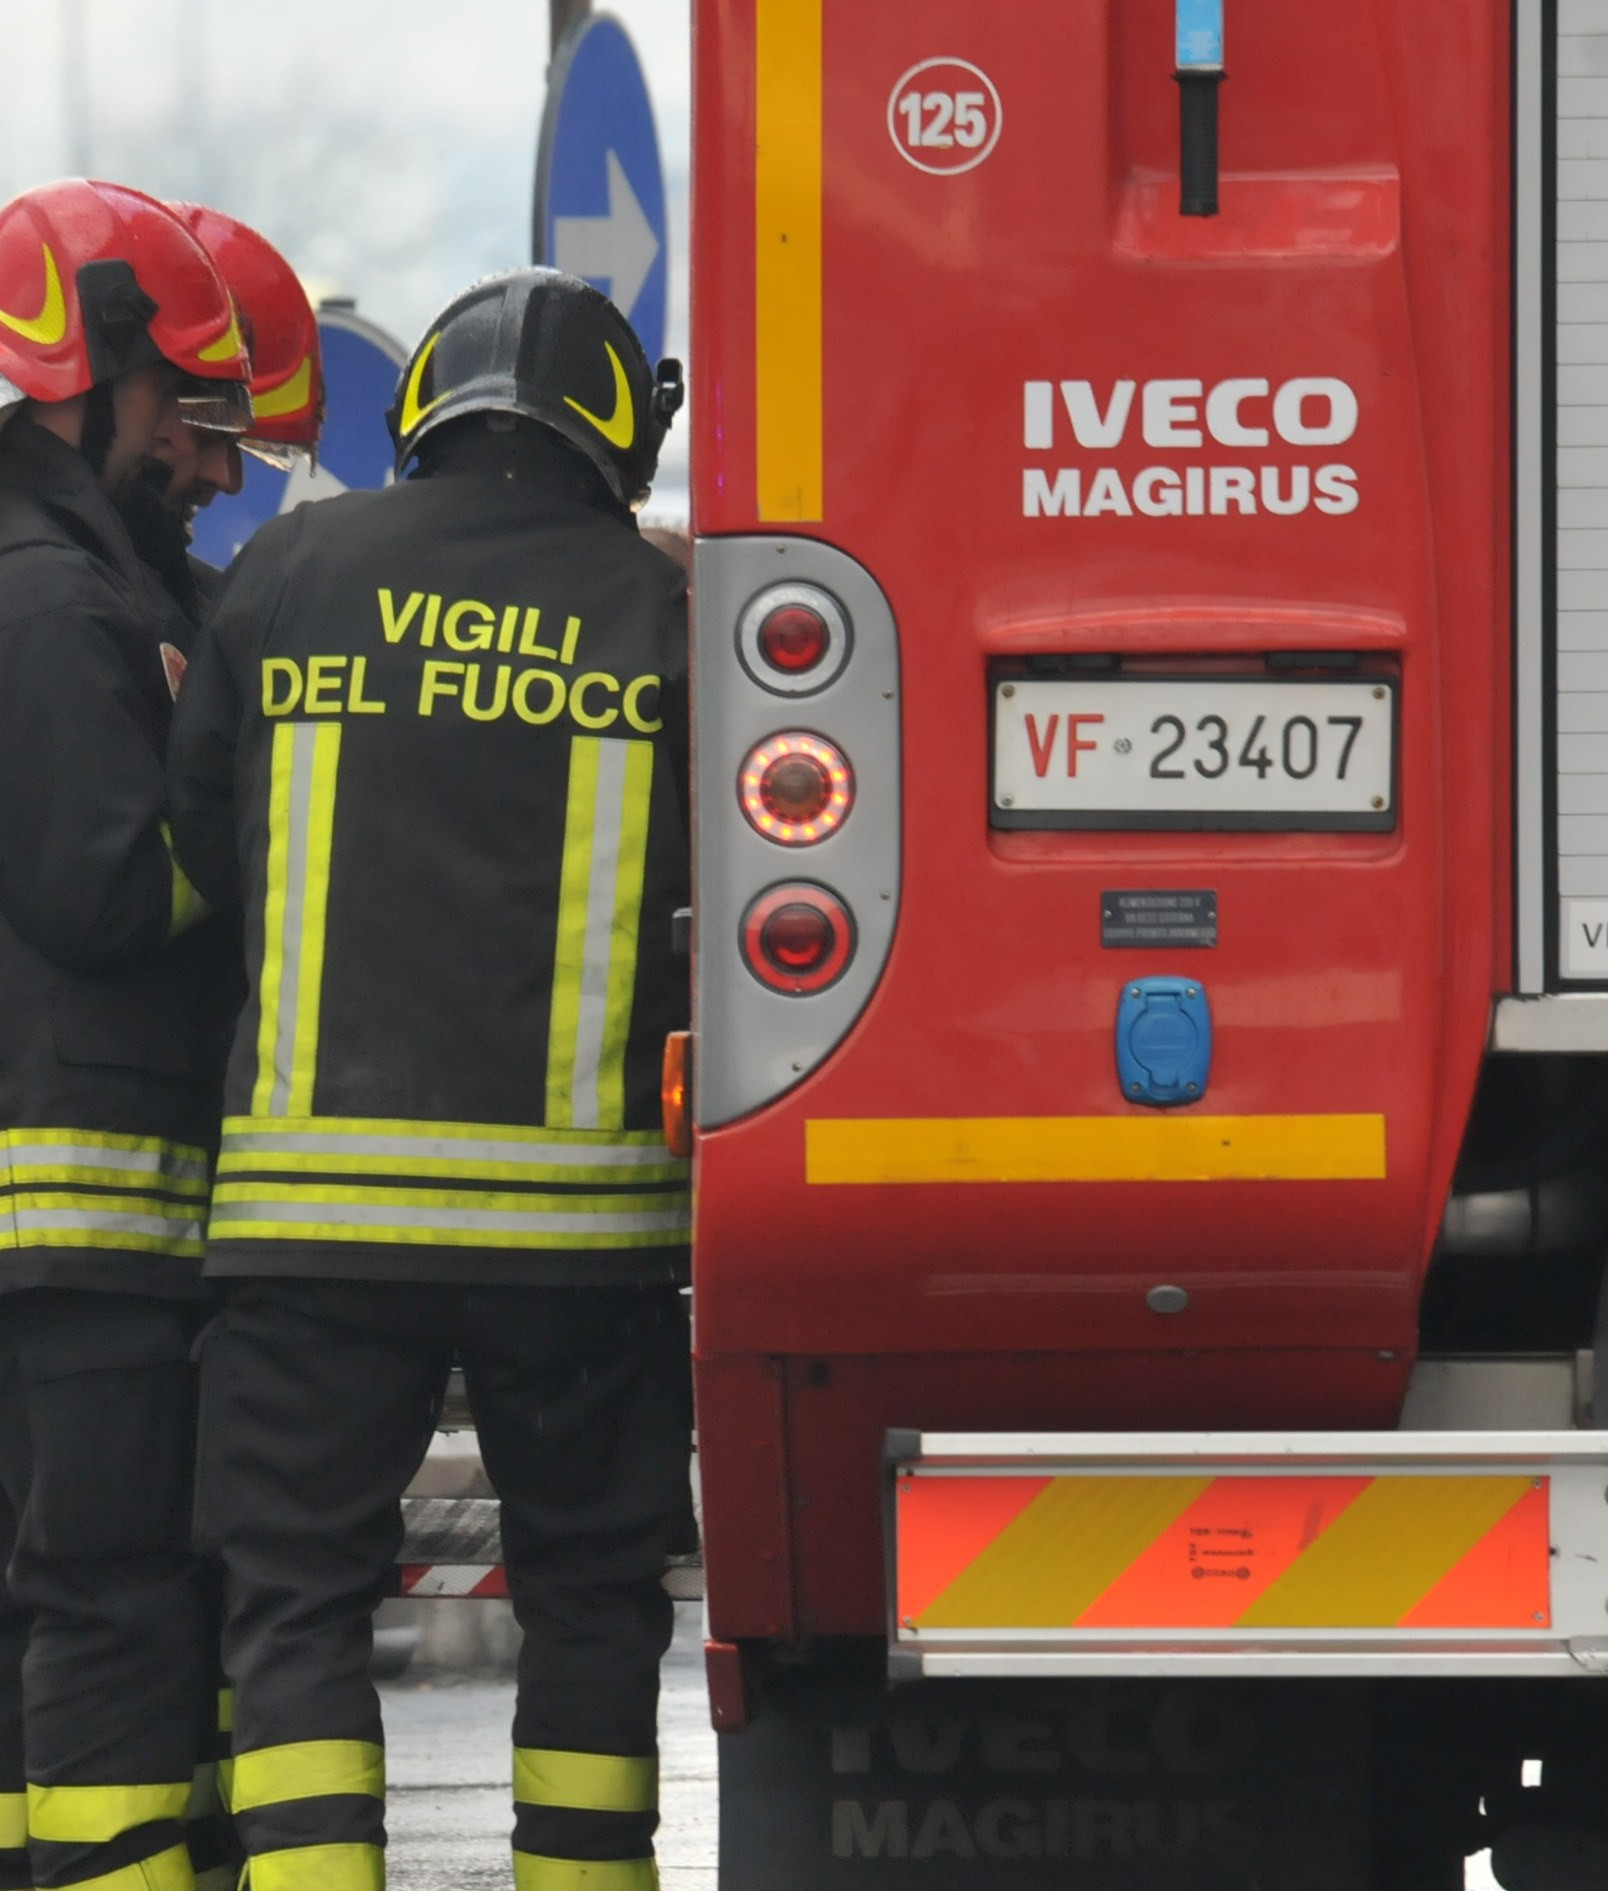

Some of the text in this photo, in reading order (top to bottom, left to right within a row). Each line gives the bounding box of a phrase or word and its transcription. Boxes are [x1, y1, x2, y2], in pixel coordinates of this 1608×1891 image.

[899, 91, 987, 148] 125
[1023, 377, 1359, 449] IVECO
[1022, 464, 1360, 517] MAGIRUS
[377, 588, 582, 665] VIGILI
[262, 656, 387, 717] DEL
[1024, 713, 1364, 781] VF 23407
